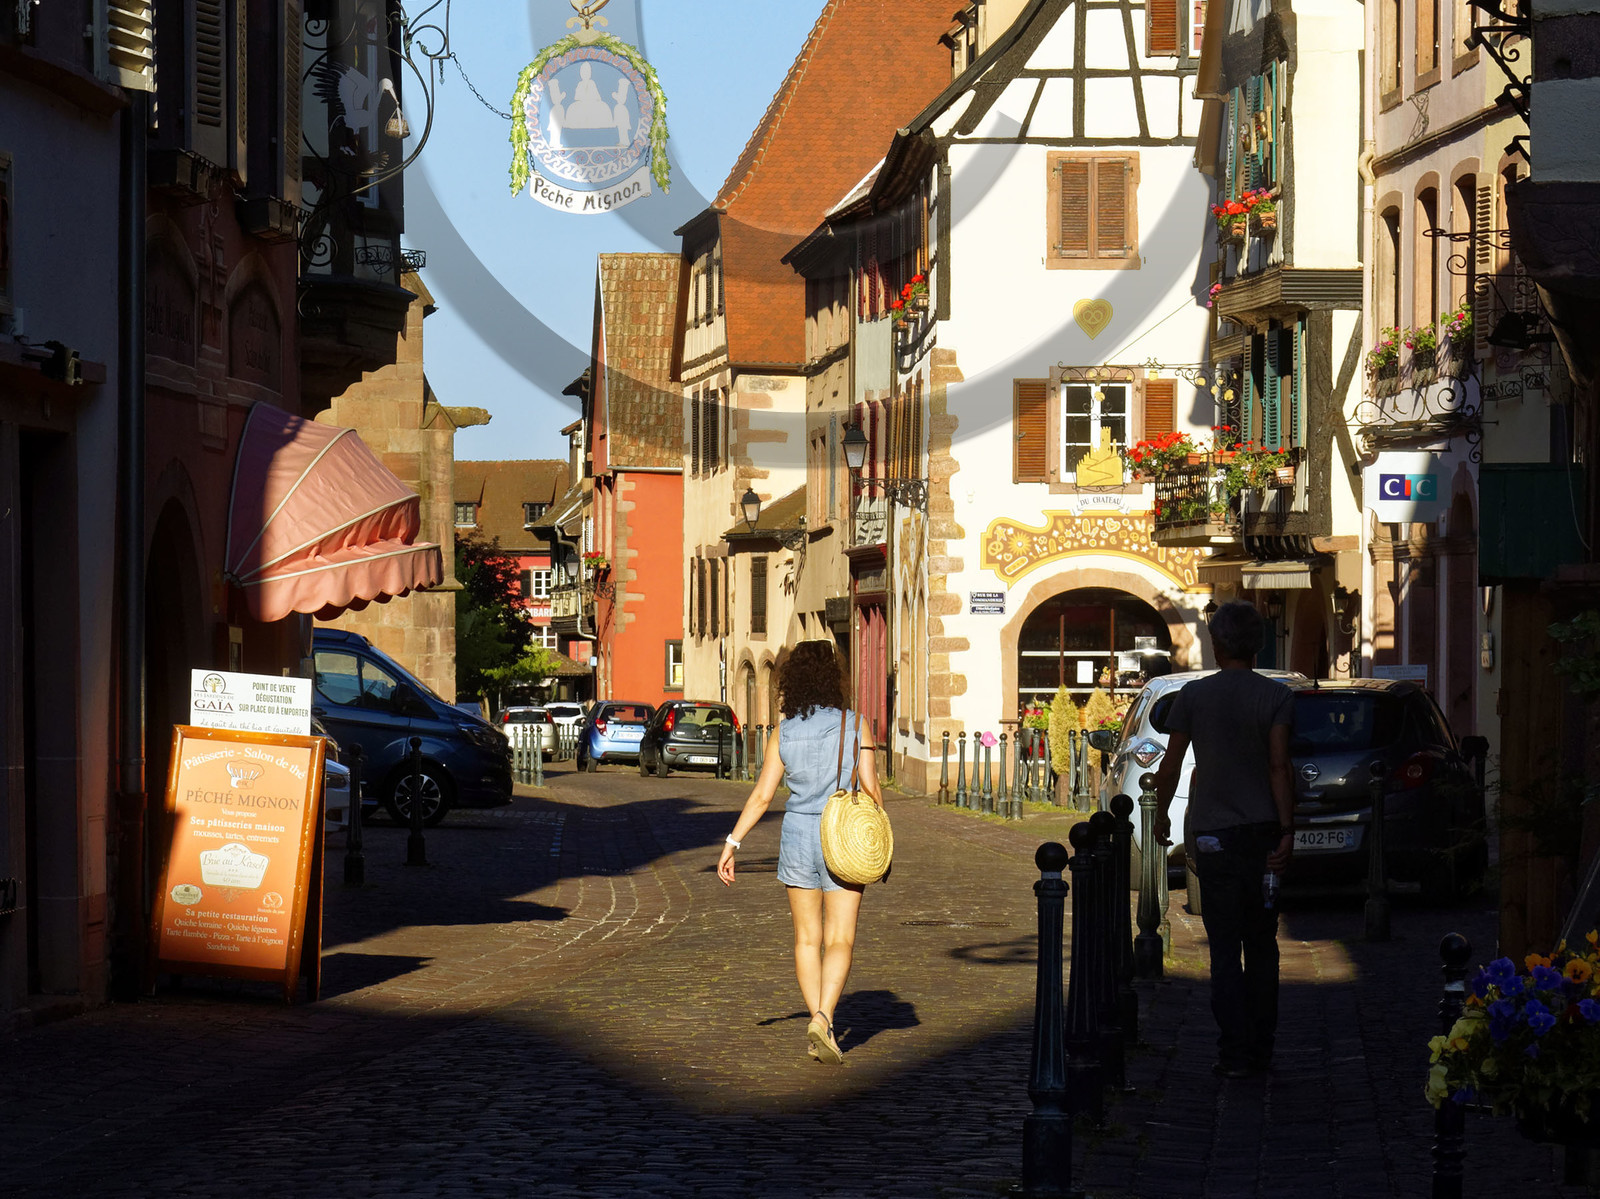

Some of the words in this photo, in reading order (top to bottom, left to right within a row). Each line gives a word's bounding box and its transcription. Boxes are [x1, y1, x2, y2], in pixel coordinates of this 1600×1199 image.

[534, 178, 573, 208] Péché
[582, 181, 641, 210] Mignon
[1384, 479, 1431, 496] CIC
[1080, 498, 1089, 506] DU
[1092, 496, 1122, 504] CHATEAU
[253, 682, 268, 691] POINT
[270, 683, 277, 692] DE
[278, 684, 296, 693] VENTE
[194, 699, 233, 711] GAÏA
[255, 693, 292, 704] DÉGUSTATION
[239, 704, 249, 712] SUR
[250, 705, 266, 714] PLACE
[268, 706, 275, 714] OU
[281, 707, 308, 717] EMPORTER
[184, 748, 234, 770] Pâtisserie
[244, 747, 274, 762] Salon
[275, 757, 288, 769] de
[289, 765, 306, 780] thé
[186, 788, 234, 806] PÉCHÉ
[238, 795, 300, 810] MIGNON
[190, 817, 204, 825] Ses
[207, 817, 252, 830] pâtisseries
[255, 823, 285, 832] maison
[247, 835, 279, 843] entremets
[186, 908, 195, 916] Sa
[197, 909, 220, 919] petite
[222, 912, 268, 922] restauration
[174, 918, 197, 926] Quiche
[198, 921, 222, 929] lorraine
[227, 923, 250, 932] Quiche
[251, 925, 277, 934] légumes
[166, 928, 181, 936] Tarte
[183, 929, 207, 938] flambée
[213, 932, 230, 940] Pizza
[236, 934, 251, 942] Tarte
[206, 942, 240, 952] Sandwichs
